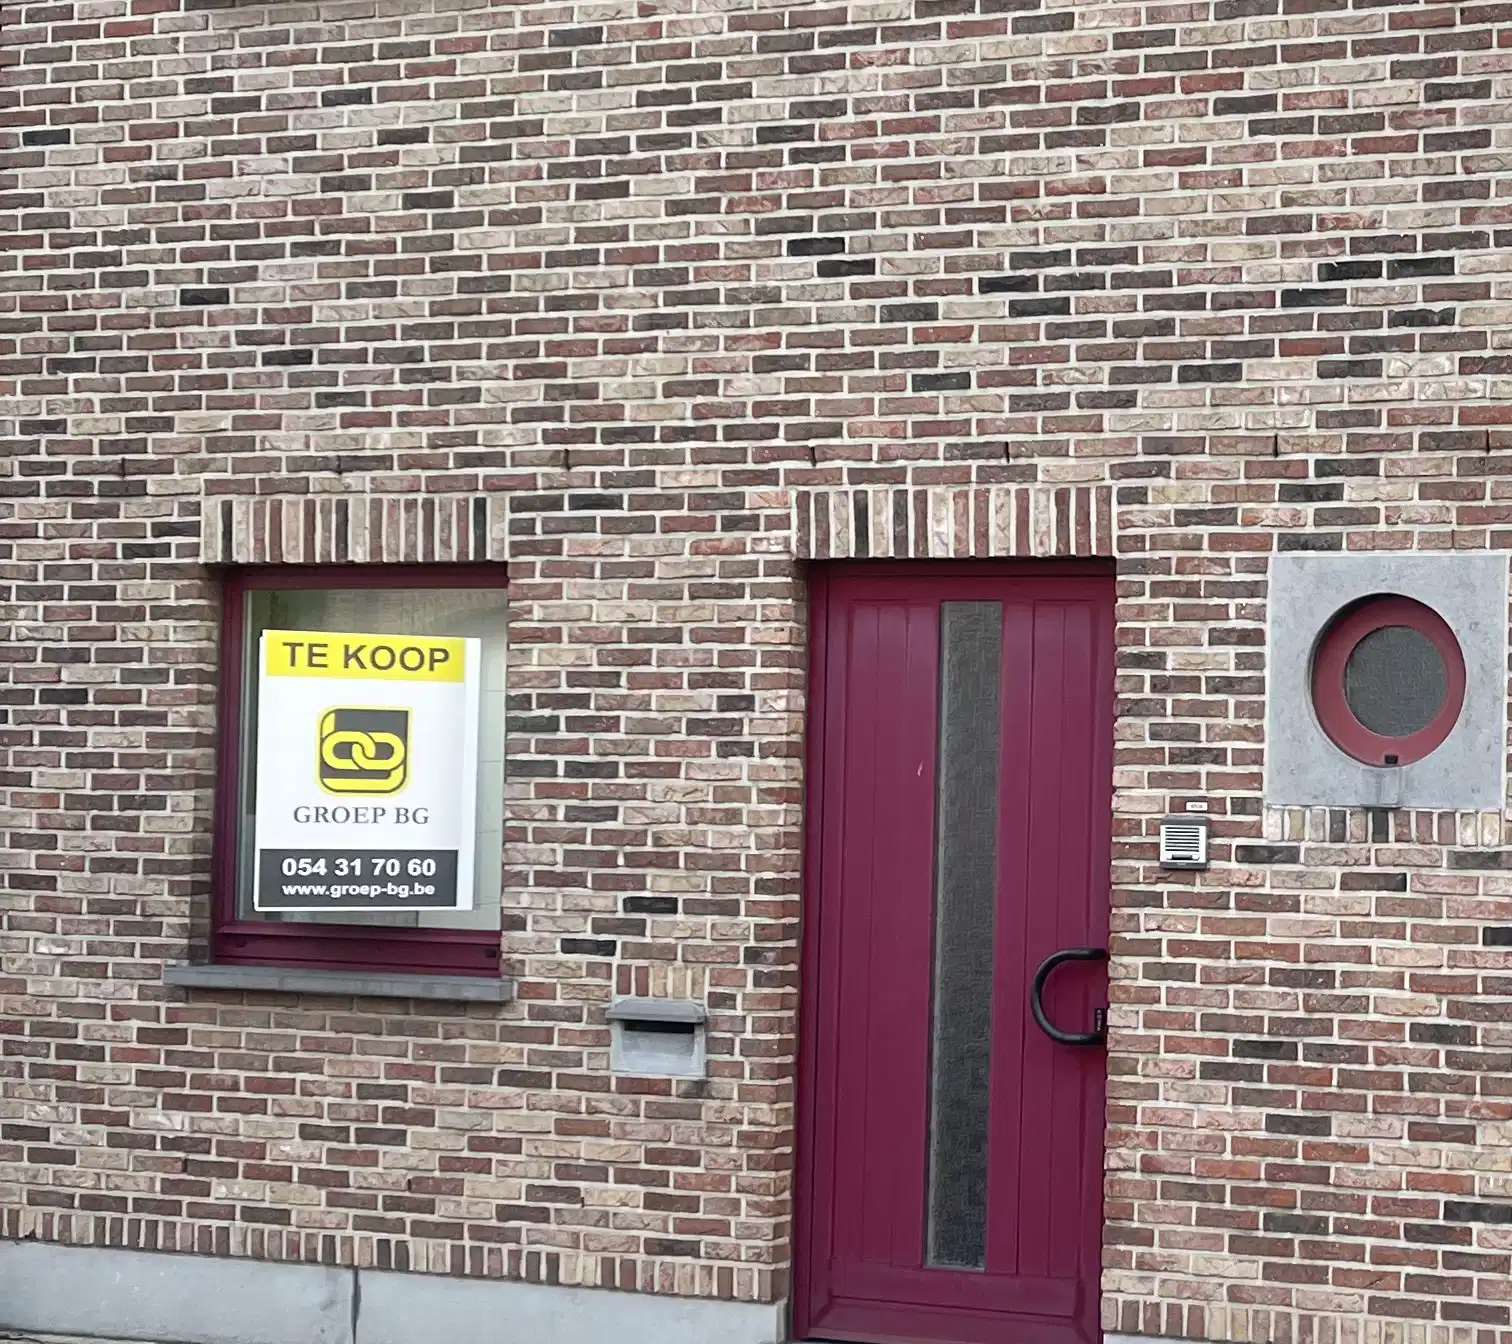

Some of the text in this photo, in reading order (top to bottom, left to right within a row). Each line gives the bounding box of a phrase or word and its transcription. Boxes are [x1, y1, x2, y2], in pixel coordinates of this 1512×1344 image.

[282, 642, 450, 672] TE KOOP
[293, 806, 430, 825] GROEP BG
[282, 858, 437, 876] 054 31 70 60
[282, 882, 436, 898] www.groep-bg.be
